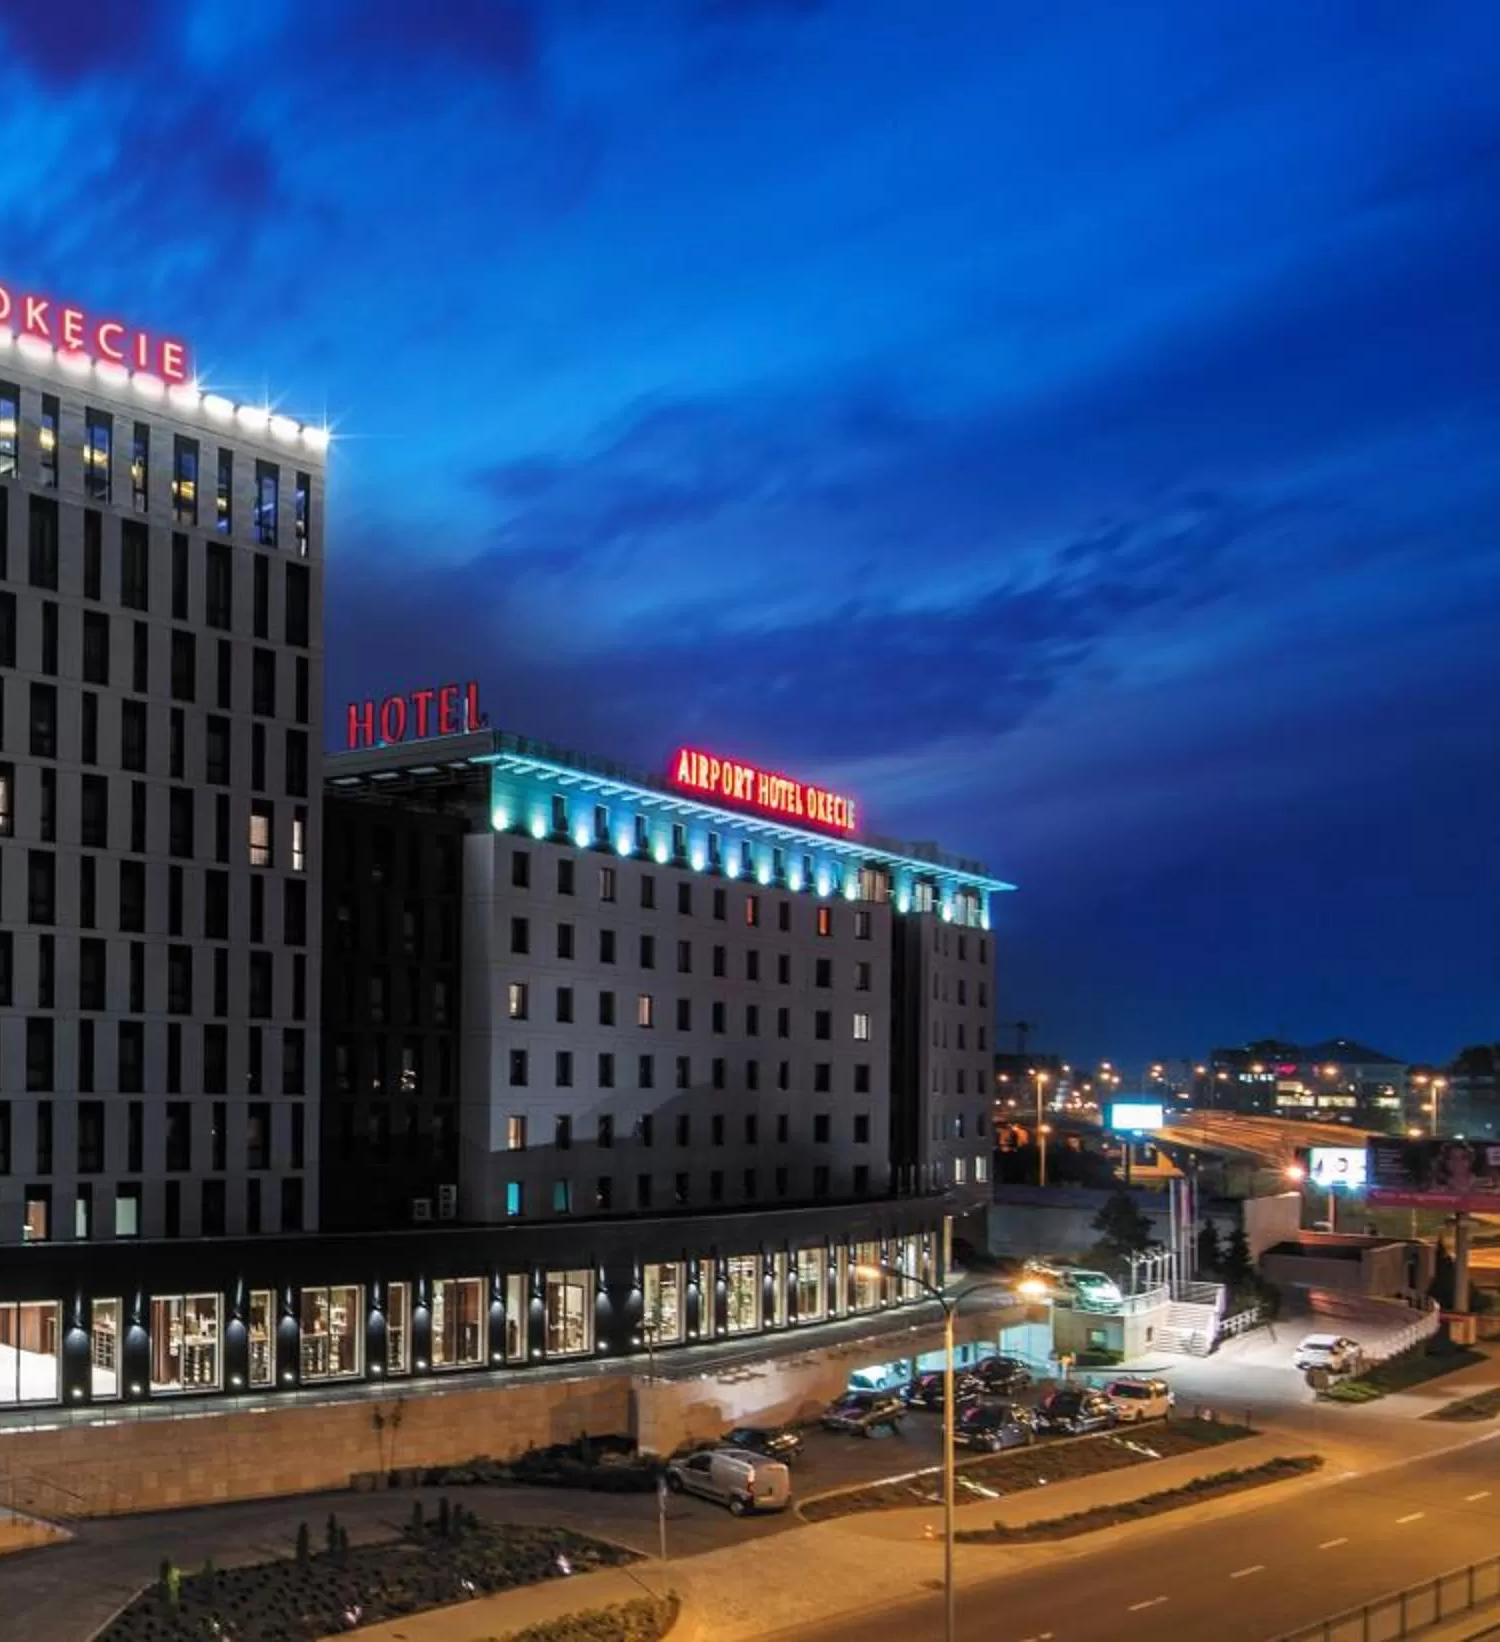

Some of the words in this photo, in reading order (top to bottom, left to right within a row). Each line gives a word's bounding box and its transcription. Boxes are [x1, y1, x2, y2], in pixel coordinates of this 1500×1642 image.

[347, 680, 484, 749] HOTEL
[677, 748, 754, 801] AIRPORT
[758, 772, 803, 815] HOTEL
